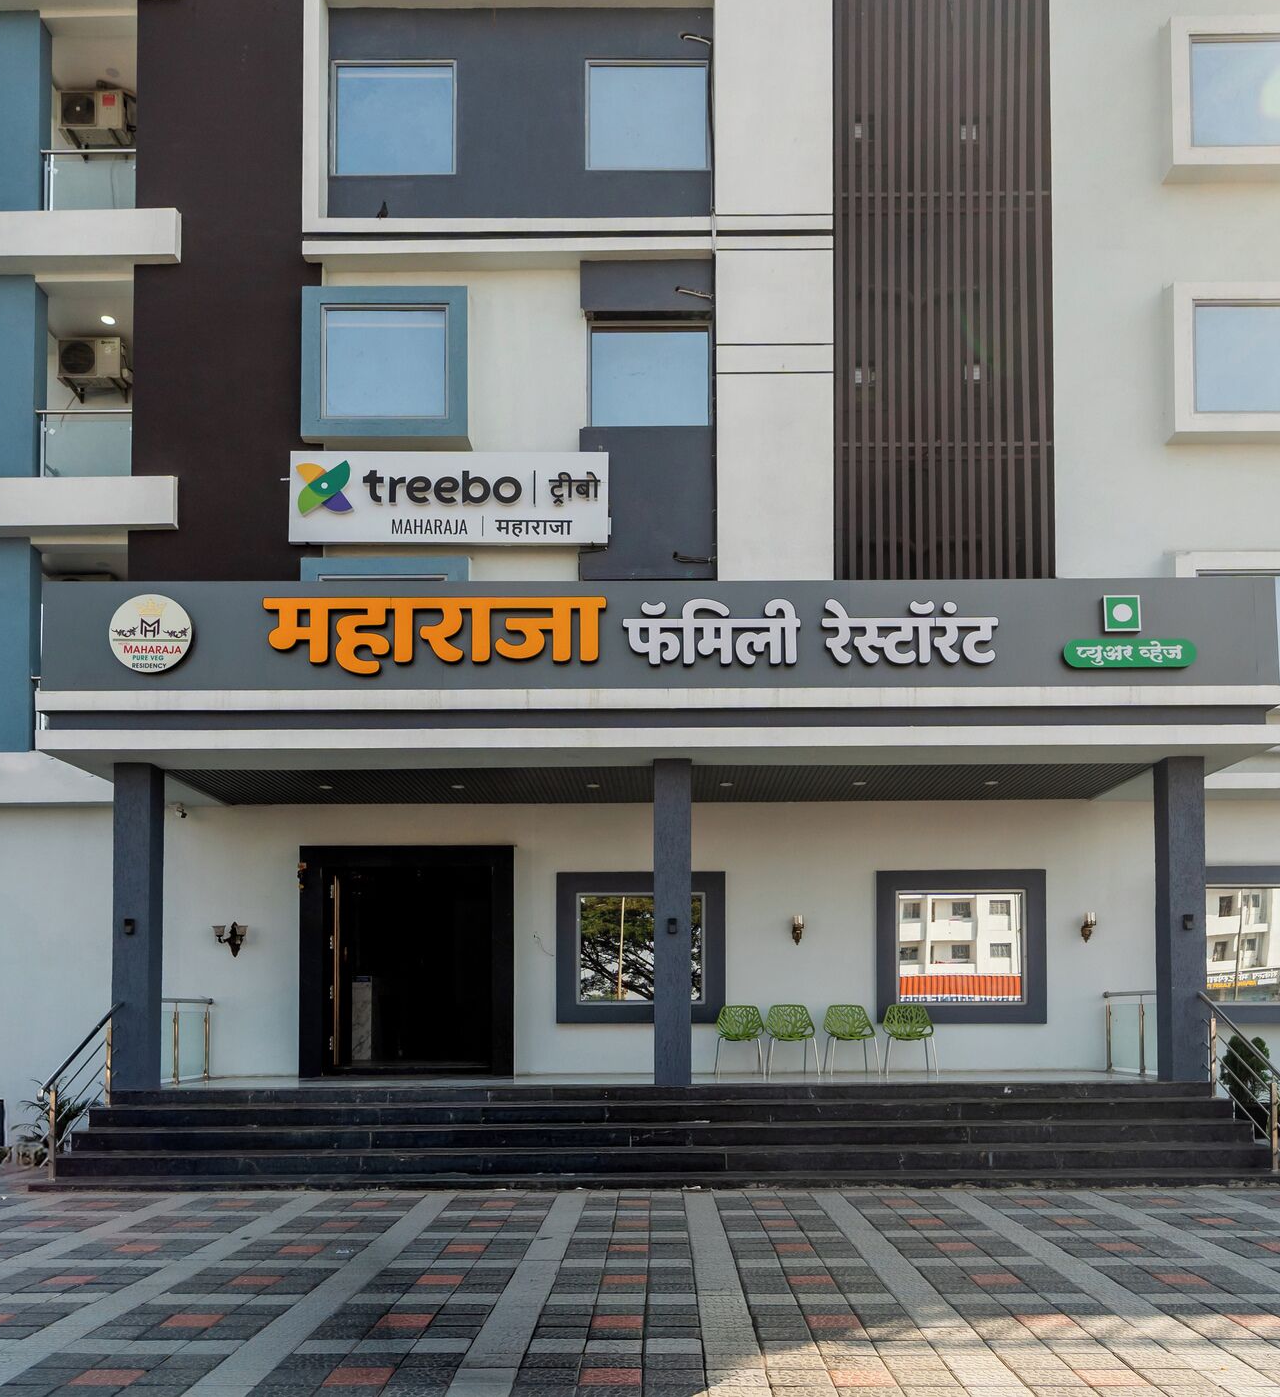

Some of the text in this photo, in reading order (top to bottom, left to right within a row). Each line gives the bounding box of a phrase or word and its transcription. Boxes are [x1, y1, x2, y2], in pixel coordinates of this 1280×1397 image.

[362, 470, 522, 504] treebo
[548, 471, 602, 505] ट्रीबो
[391, 519, 468, 535] MAHARAJA
[495, 519, 573, 537] महाराजा
[262, 596, 1000, 675] महाराजा फॅमिली रेस्टॉरंट
[123, 645, 182, 655] MAHARAJA
[1138, 640, 1183, 663] व्हेज
